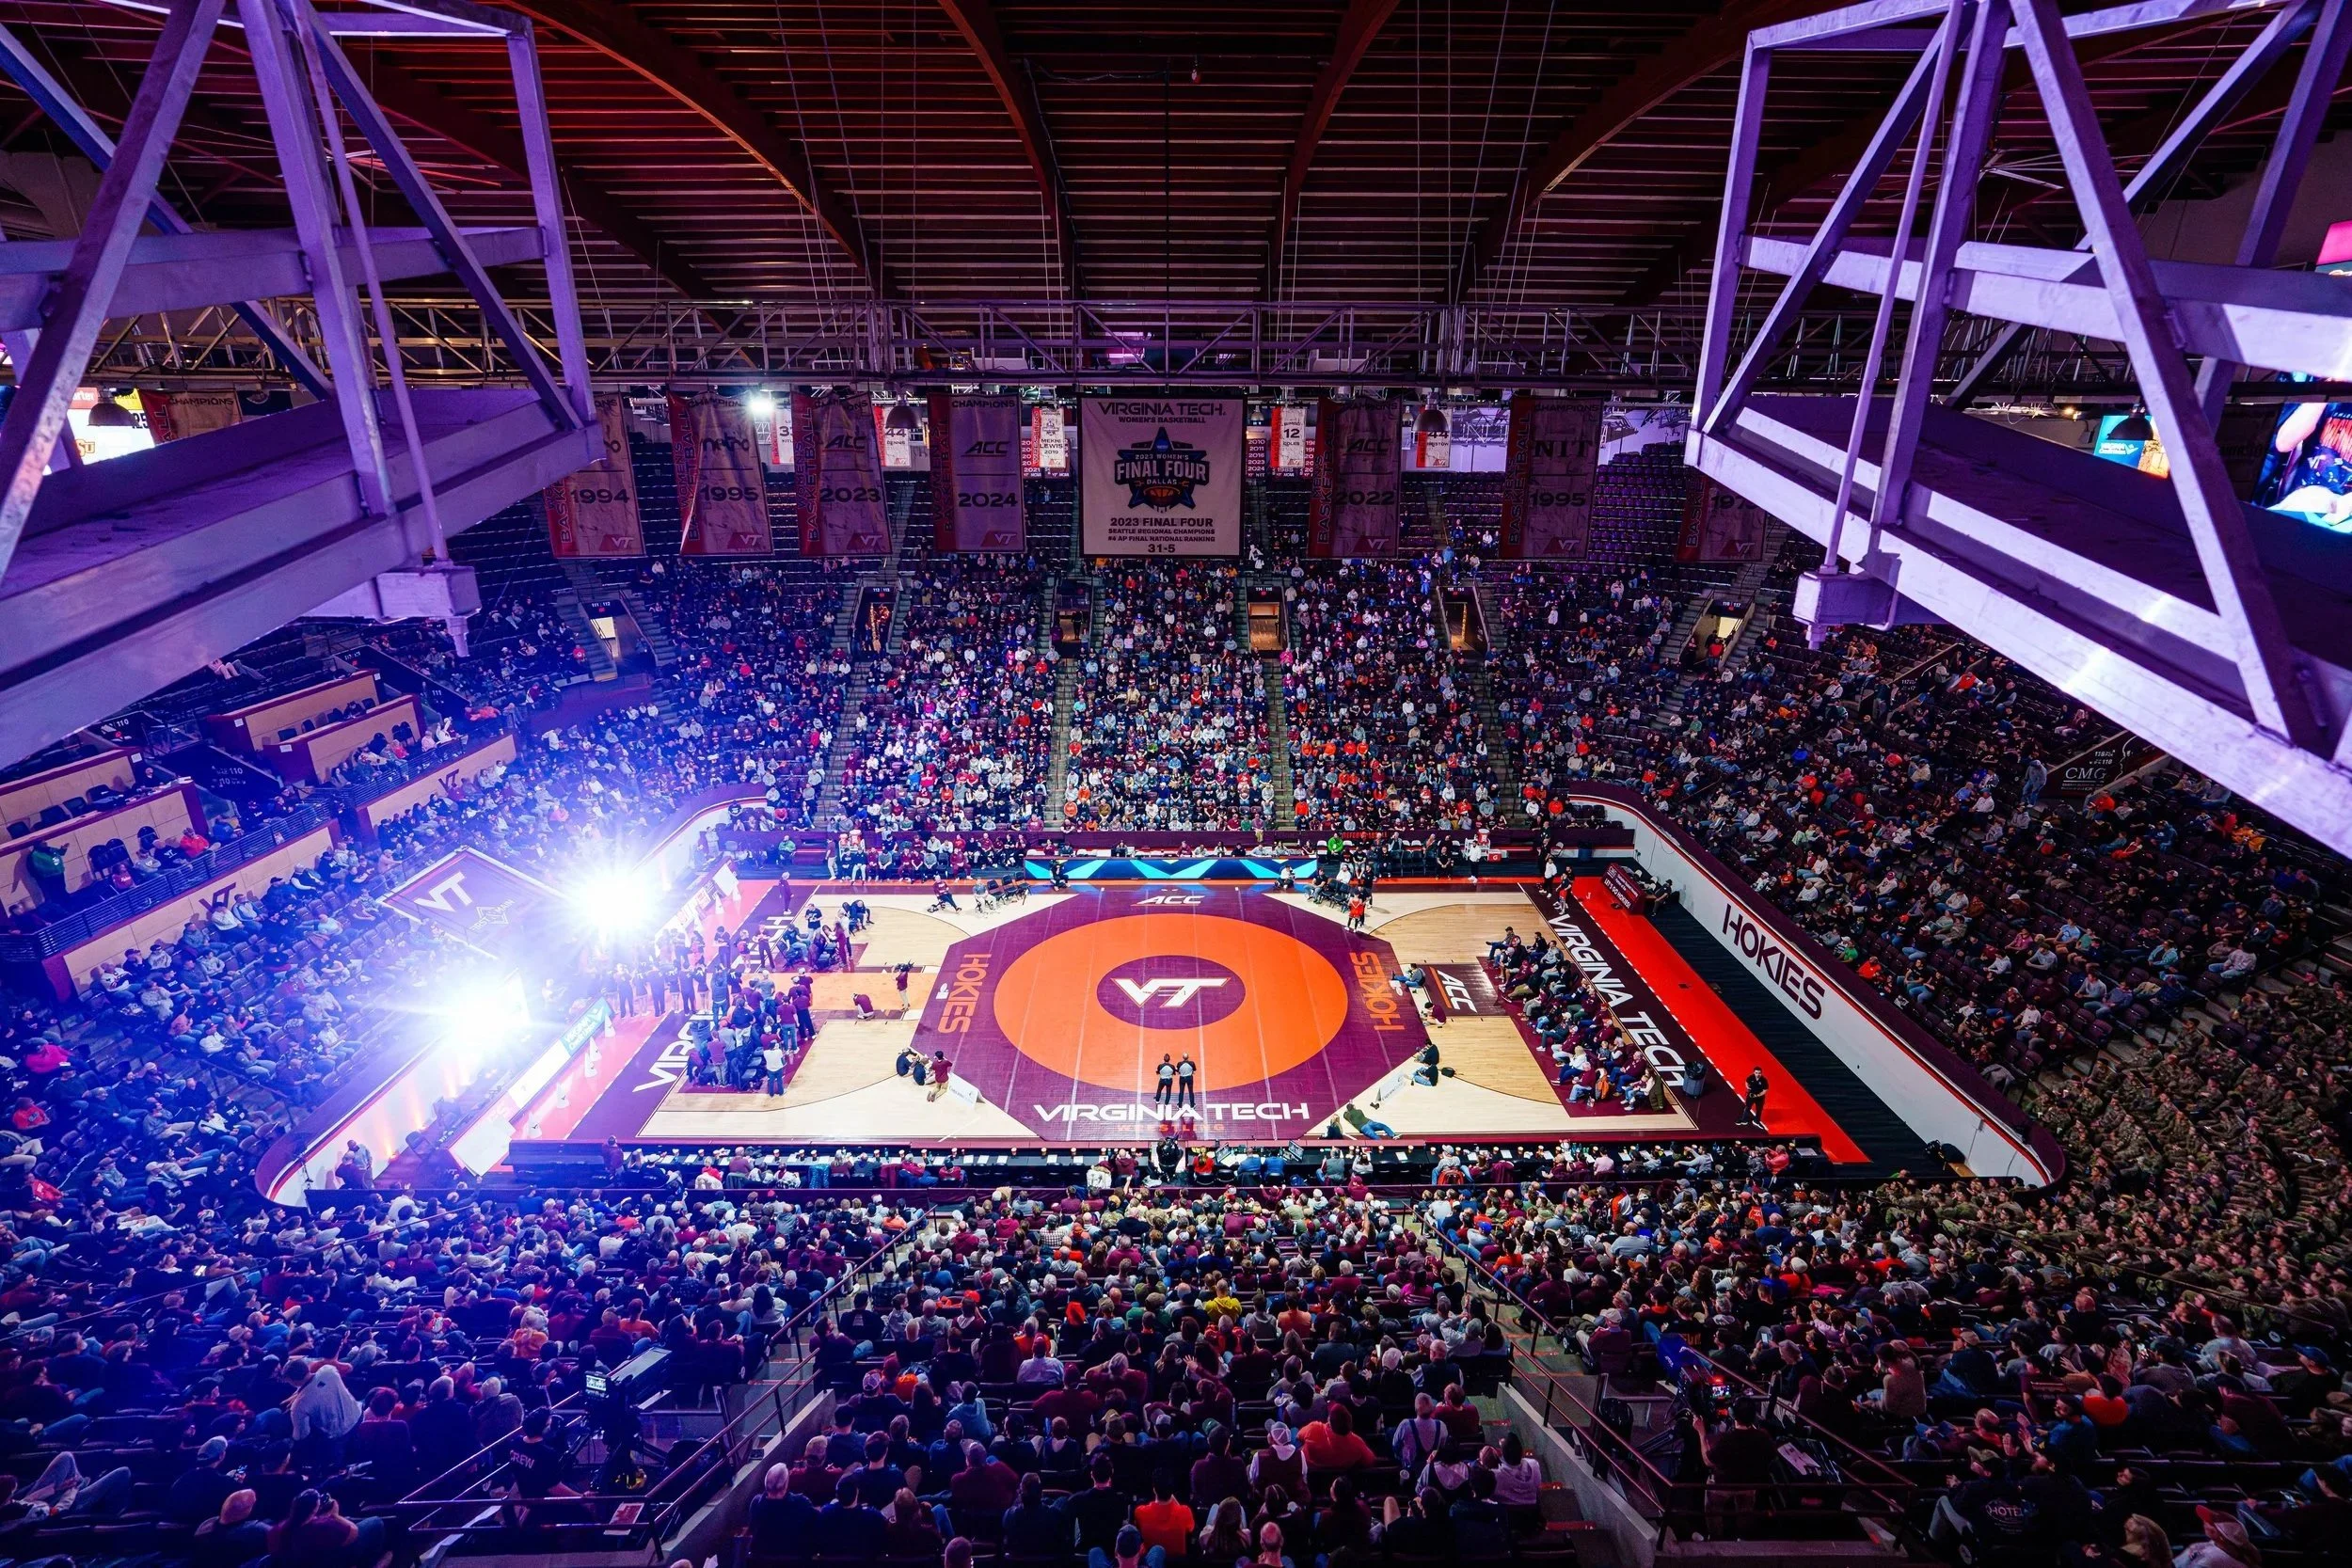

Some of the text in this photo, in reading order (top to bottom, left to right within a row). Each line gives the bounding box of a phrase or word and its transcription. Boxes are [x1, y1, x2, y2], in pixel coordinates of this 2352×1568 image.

[168, 397, 233, 406] CHAMPIONS
[1098, 402, 1224, 416] VIRGINIA TECH
[1283, 429, 1300, 438] 12
[824, 436, 866, 451] ACC
[965, 441, 1009, 453] ACC
[1348, 438, 1391, 452] ACC
[1535, 440, 1593, 457] NIT
[802, 408, 818, 541] BASKETBALL
[1117, 461, 1206, 481] FINAL FOUR
[571, 488, 629, 504] 1994
[701, 486, 758, 502] 1995
[820, 487, 881, 503] 2023
[958, 493, 1017, 508] 2024
[1336, 491, 1394, 505] 2022
[1530, 492, 1586, 506] 1995
[1110, 517, 1214, 527] 2023 FINAL FOUR
[993, 533, 1017, 545] VT
[1367, 539, 1390, 549] VT
[1148, 544, 1176, 553] 31-5
[117, 719, 130, 727] 110
[2065, 768, 2106, 779] CMG
[414, 871, 472, 912] VT
[1136, 895, 1205, 905] ACC
[1549, 913, 1633, 1008] VIRGINIA
[1723, 904, 1825, 1020] HOKIES
[937, 953, 992, 1034] HOKIES
[1111, 977, 1231, 1007] VT
[1349, 951, 1405, 1031] HOKIES
[1438, 970, 1477, 1013] ACC
[1034, 1102, 1310, 1121] VIRGINIA TECH
[1118, 1123, 1225, 1132] WRESTLING
[509, 1449, 535, 1469] CREW
